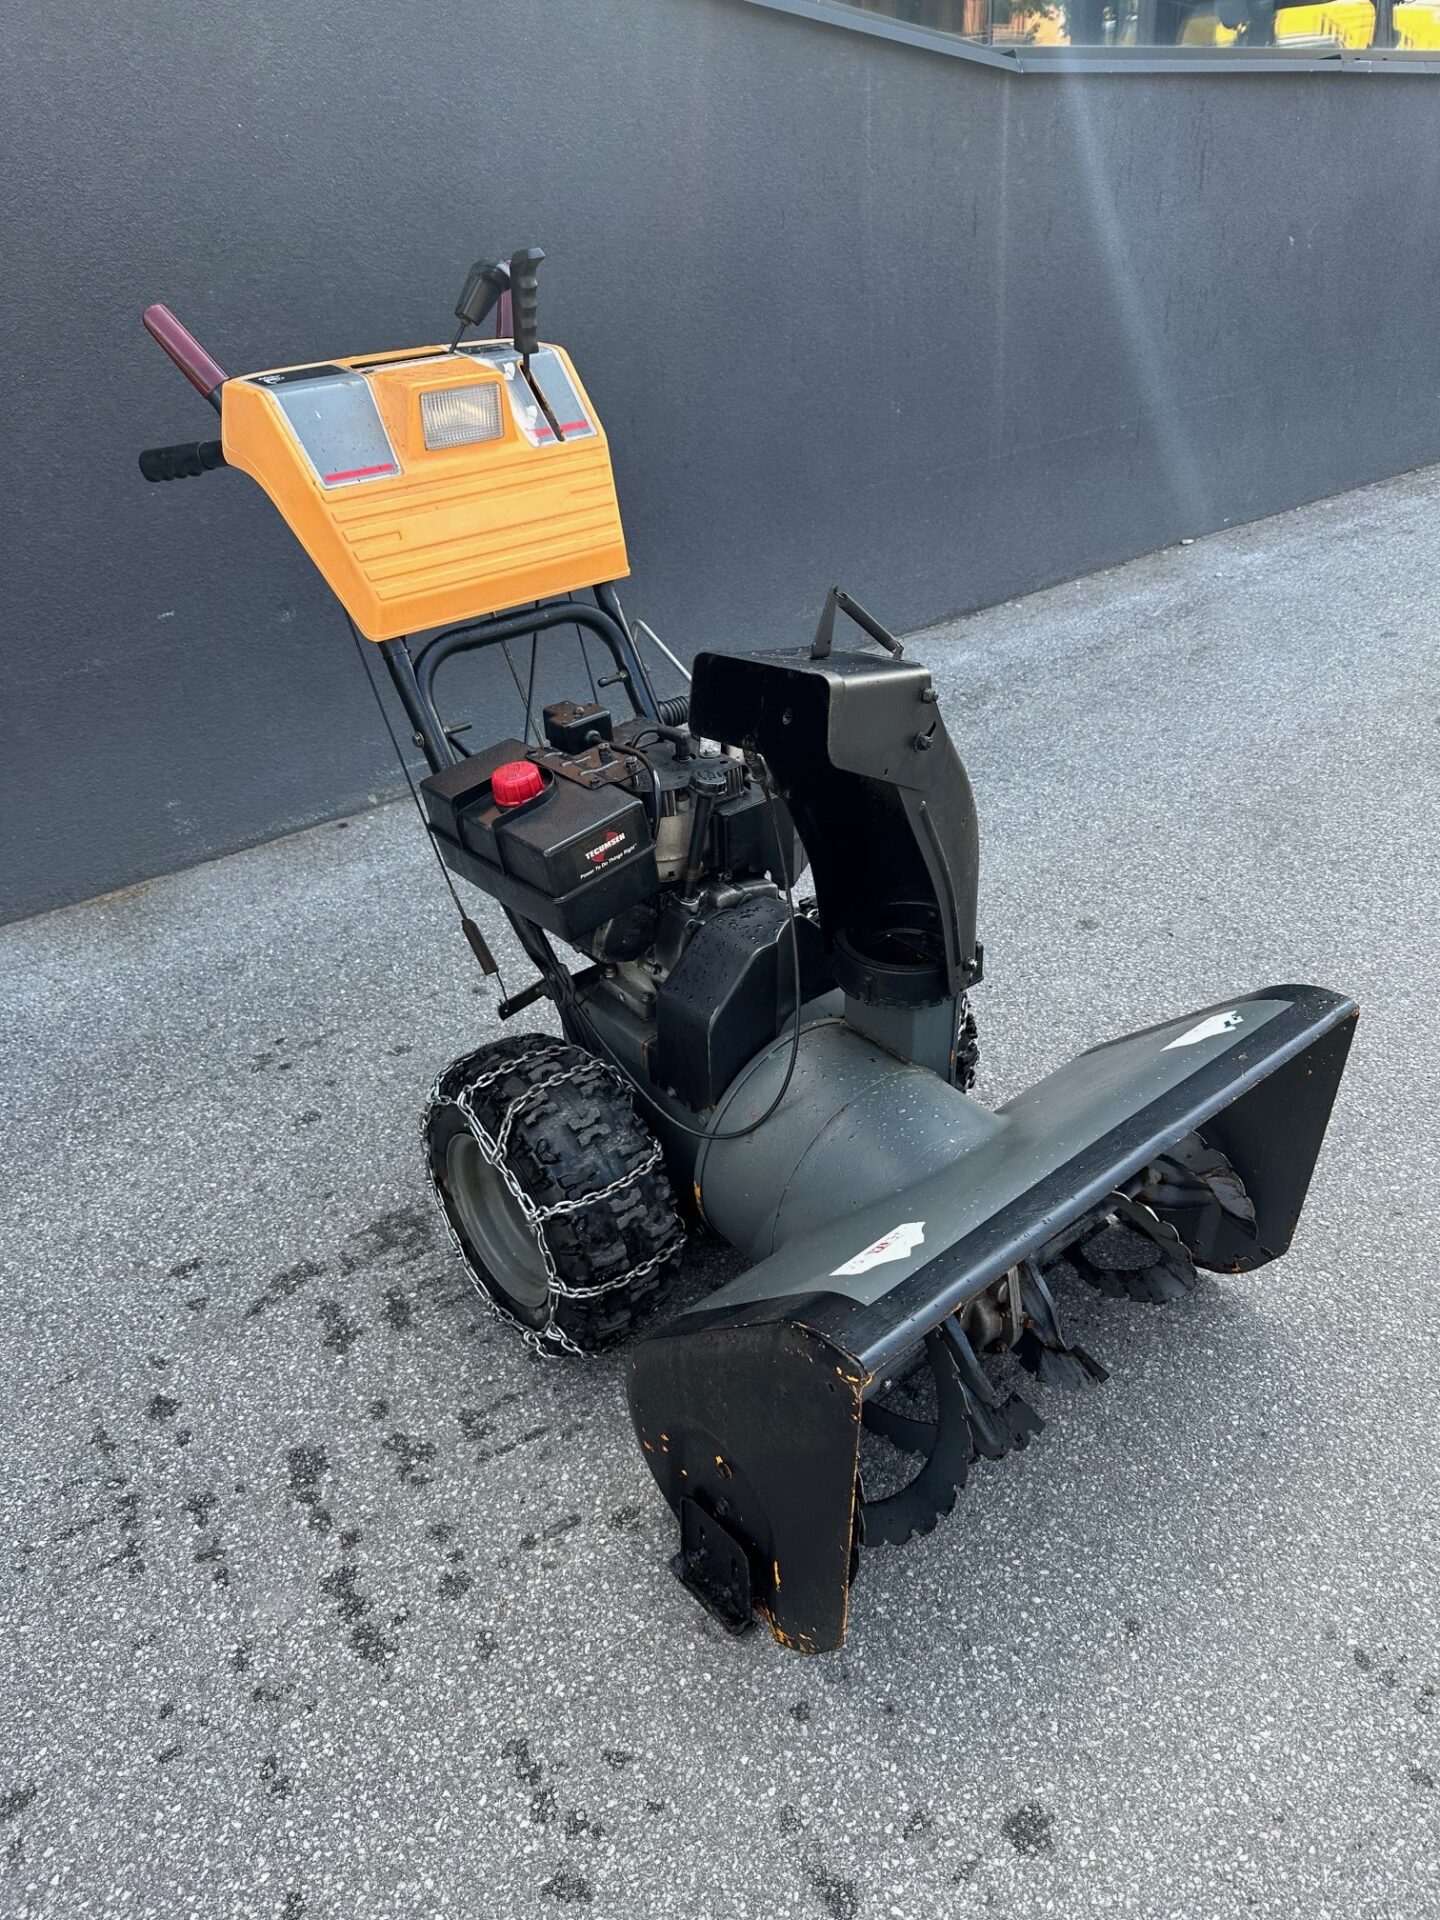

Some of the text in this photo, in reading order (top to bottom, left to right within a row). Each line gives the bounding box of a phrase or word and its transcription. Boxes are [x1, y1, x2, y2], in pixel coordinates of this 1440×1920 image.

[585, 833, 625, 860] TECUMSEH
[580, 869, 594, 879] Power
[608, 852, 623, 863] Things
